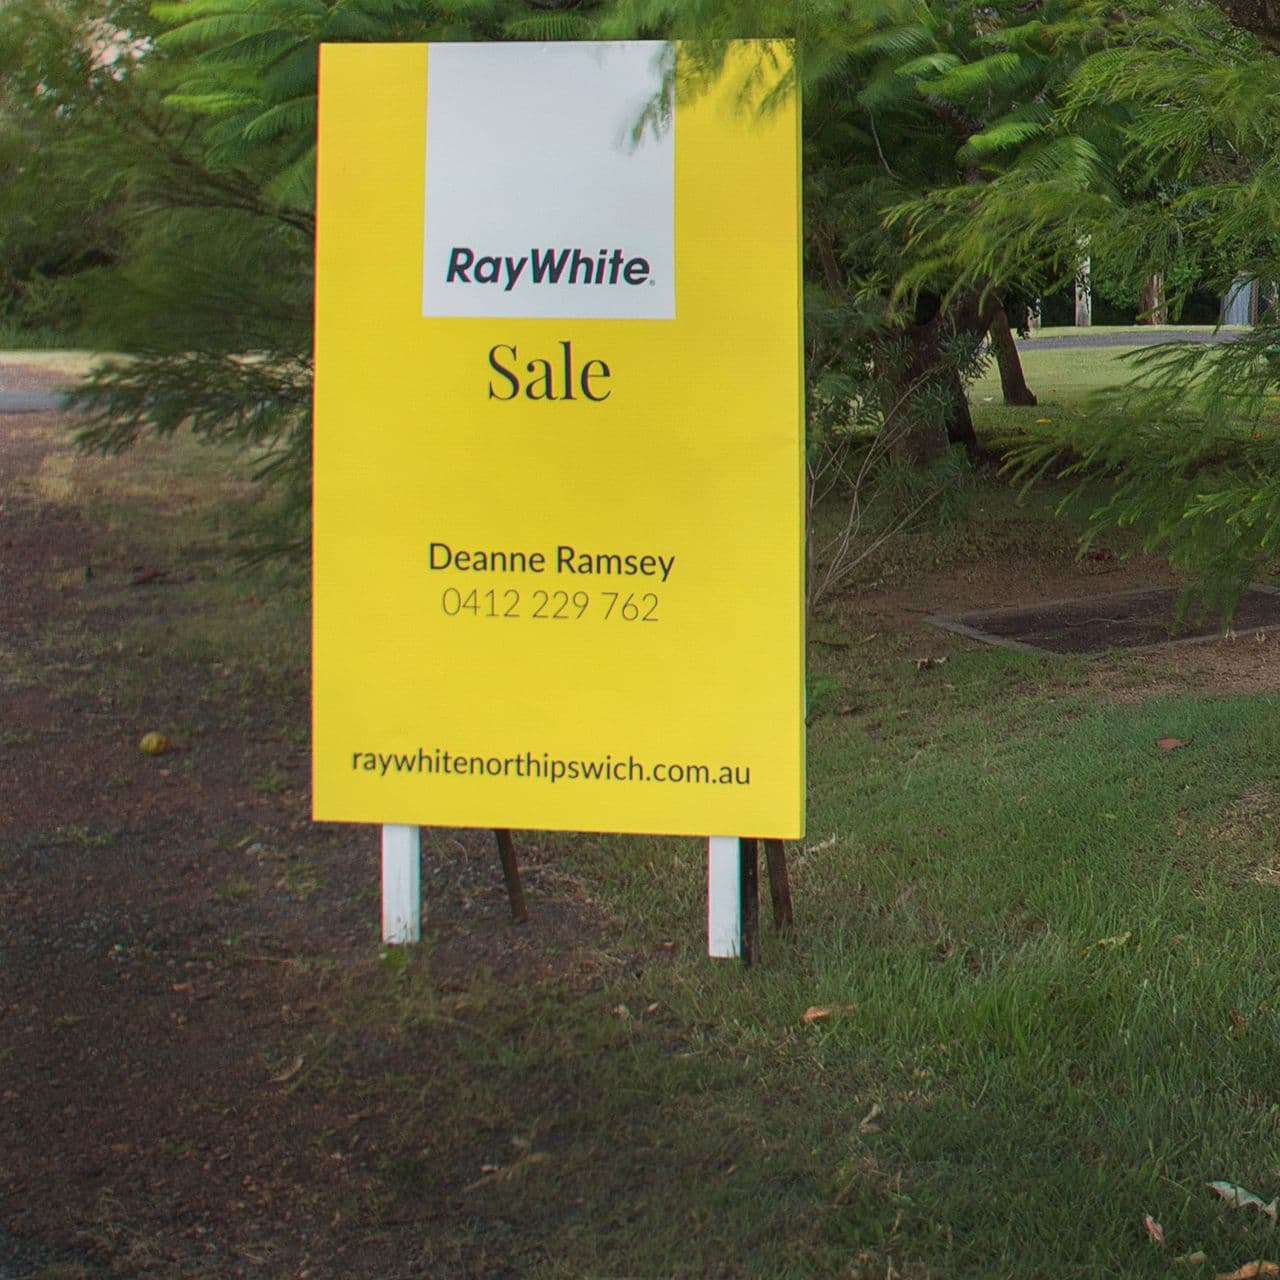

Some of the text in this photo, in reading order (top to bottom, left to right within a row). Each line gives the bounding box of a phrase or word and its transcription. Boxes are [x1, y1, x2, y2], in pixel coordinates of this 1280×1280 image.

[488, 340, 612, 402] Sale
[429, 542, 676, 582] Deanne Ramsey
[442, 587, 659, 622] 0412 229 762
[351, 746, 751, 785] raywhitenorthipswich.com.au
